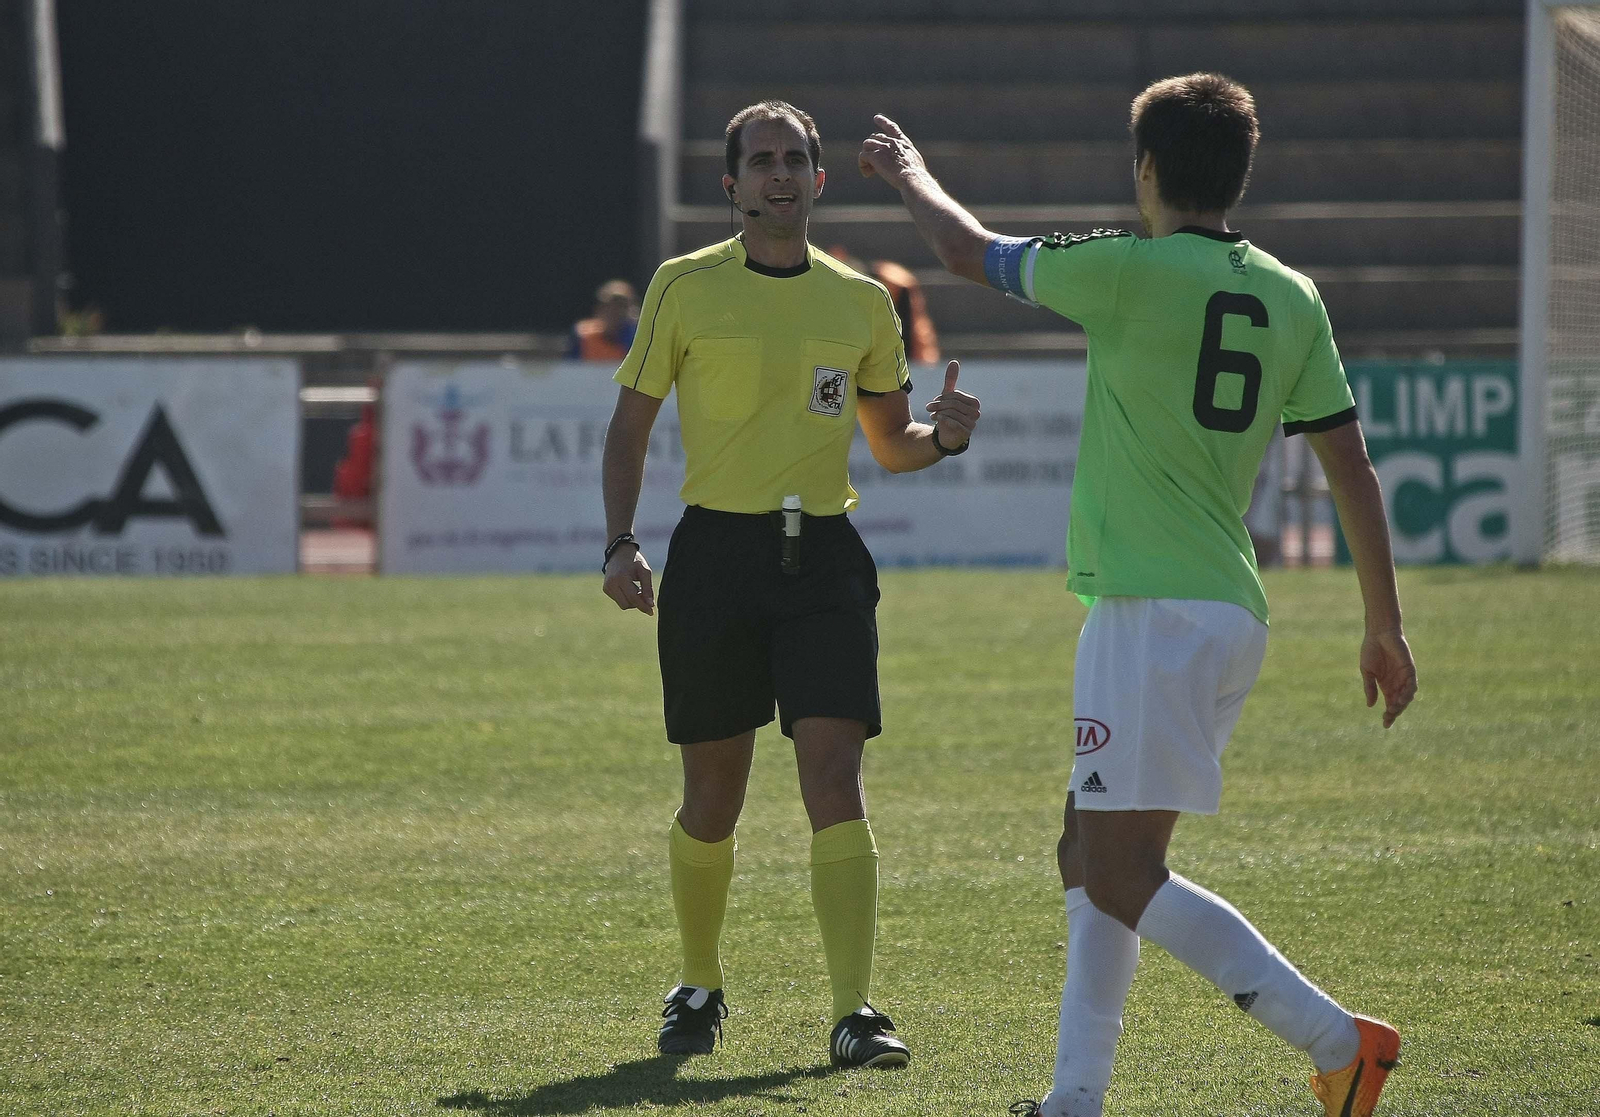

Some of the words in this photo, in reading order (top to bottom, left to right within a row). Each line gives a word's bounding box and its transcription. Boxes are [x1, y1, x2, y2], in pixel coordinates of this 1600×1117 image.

[1193, 290, 1269, 433] 6
[30, 545, 138, 574] SINCE
[1081, 784, 1107, 794] adidas
